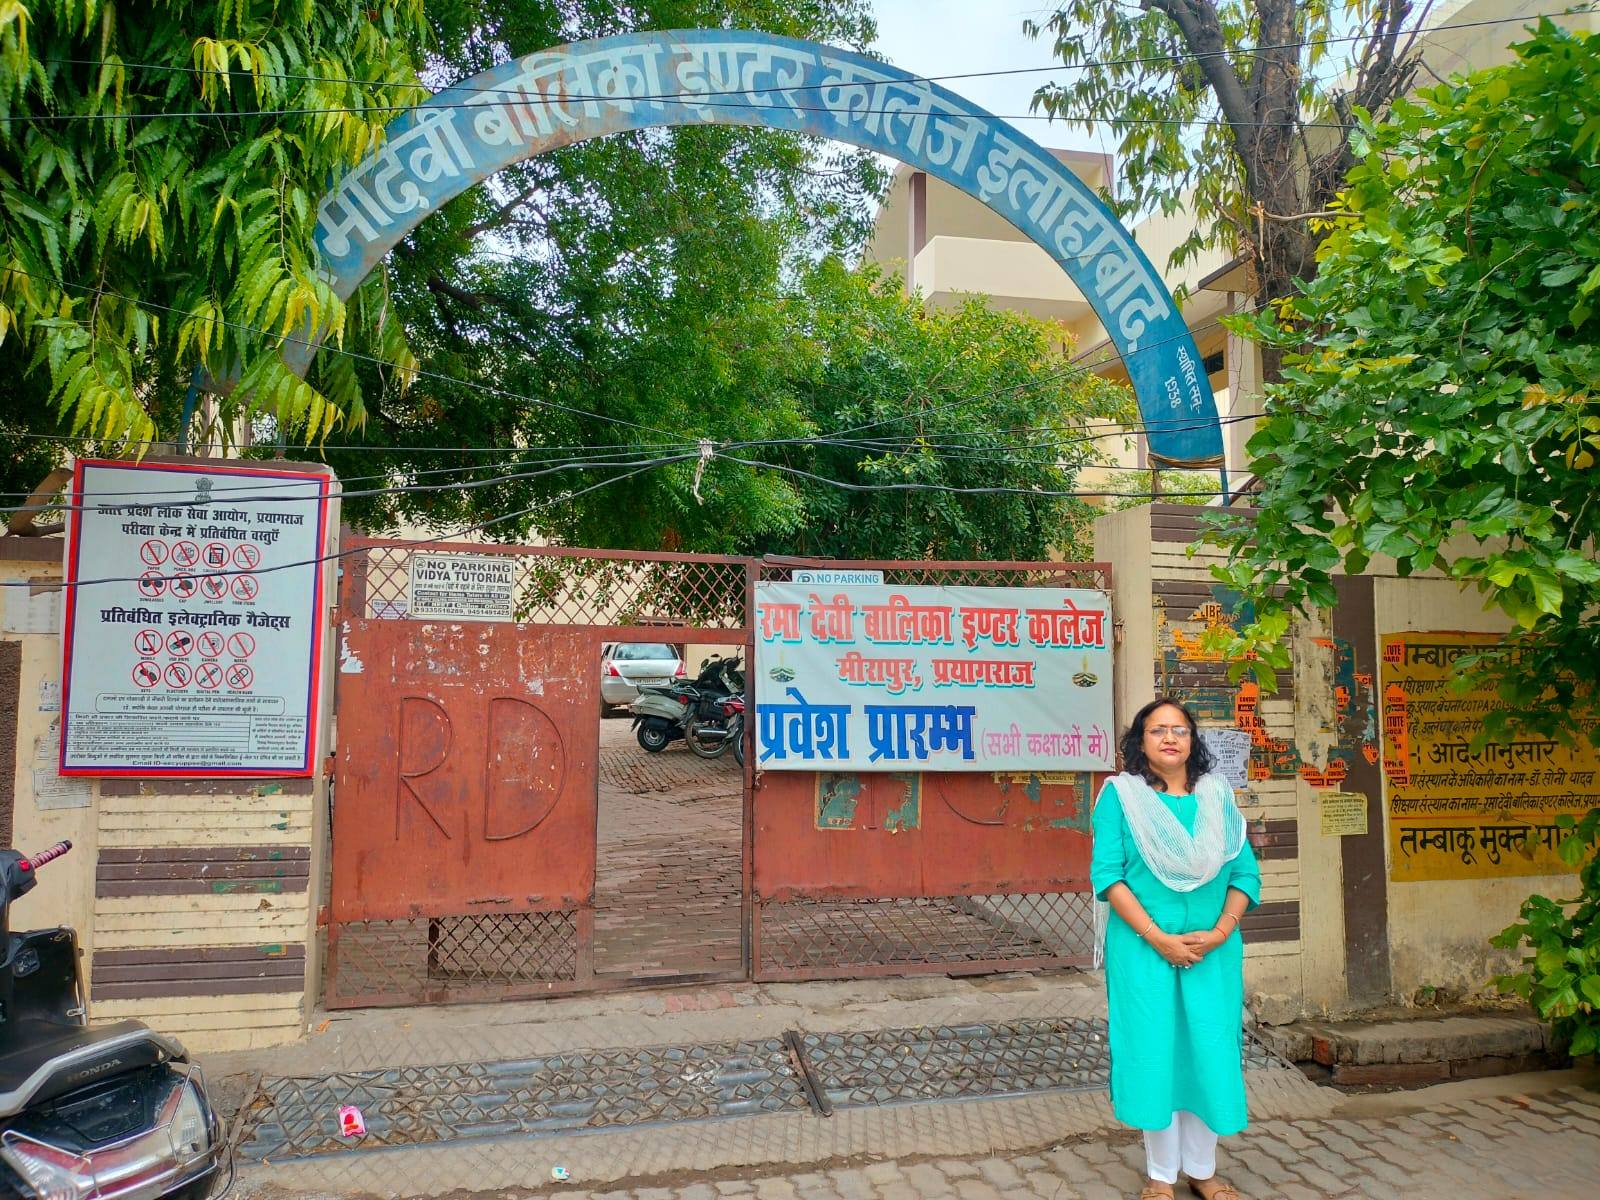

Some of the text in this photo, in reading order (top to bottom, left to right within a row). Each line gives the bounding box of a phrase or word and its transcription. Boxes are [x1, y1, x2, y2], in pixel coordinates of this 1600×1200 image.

[464, 43, 665, 138] बालिका
[670, 43, 816, 123] इण्टर
[821, 55, 987, 176] कालेज
[976, 131, 1171, 353] इलाहाबाद
[122, 521, 156, 536] परीक्षा
[159, 522, 183, 537] केन्द्र
[186, 524, 198, 538] में
[187, 504, 208, 520] सेवा
[256, 512, 305, 525] प्रयागराज
[416, 569, 511, 584] VIDYA TUTORIAL
[427, 561, 511, 574] NO PARKING
[816, 573, 879, 584] NO PARKING
[100, 606, 164, 625] प्रतिबंधित
[247, 610, 292, 632] गैजेट्स
[758, 593, 1106, 650] रमा देवी बालिका इण्टर कालेज
[836, 651, 1035, 692] मीरापुर, प्रयागराज
[756, 687, 976, 763] प्रवेश प्रारम्भ
[1026, 723, 1083, 758] कक्षाओं
[1399, 826, 1478, 865] तम्बाकू
